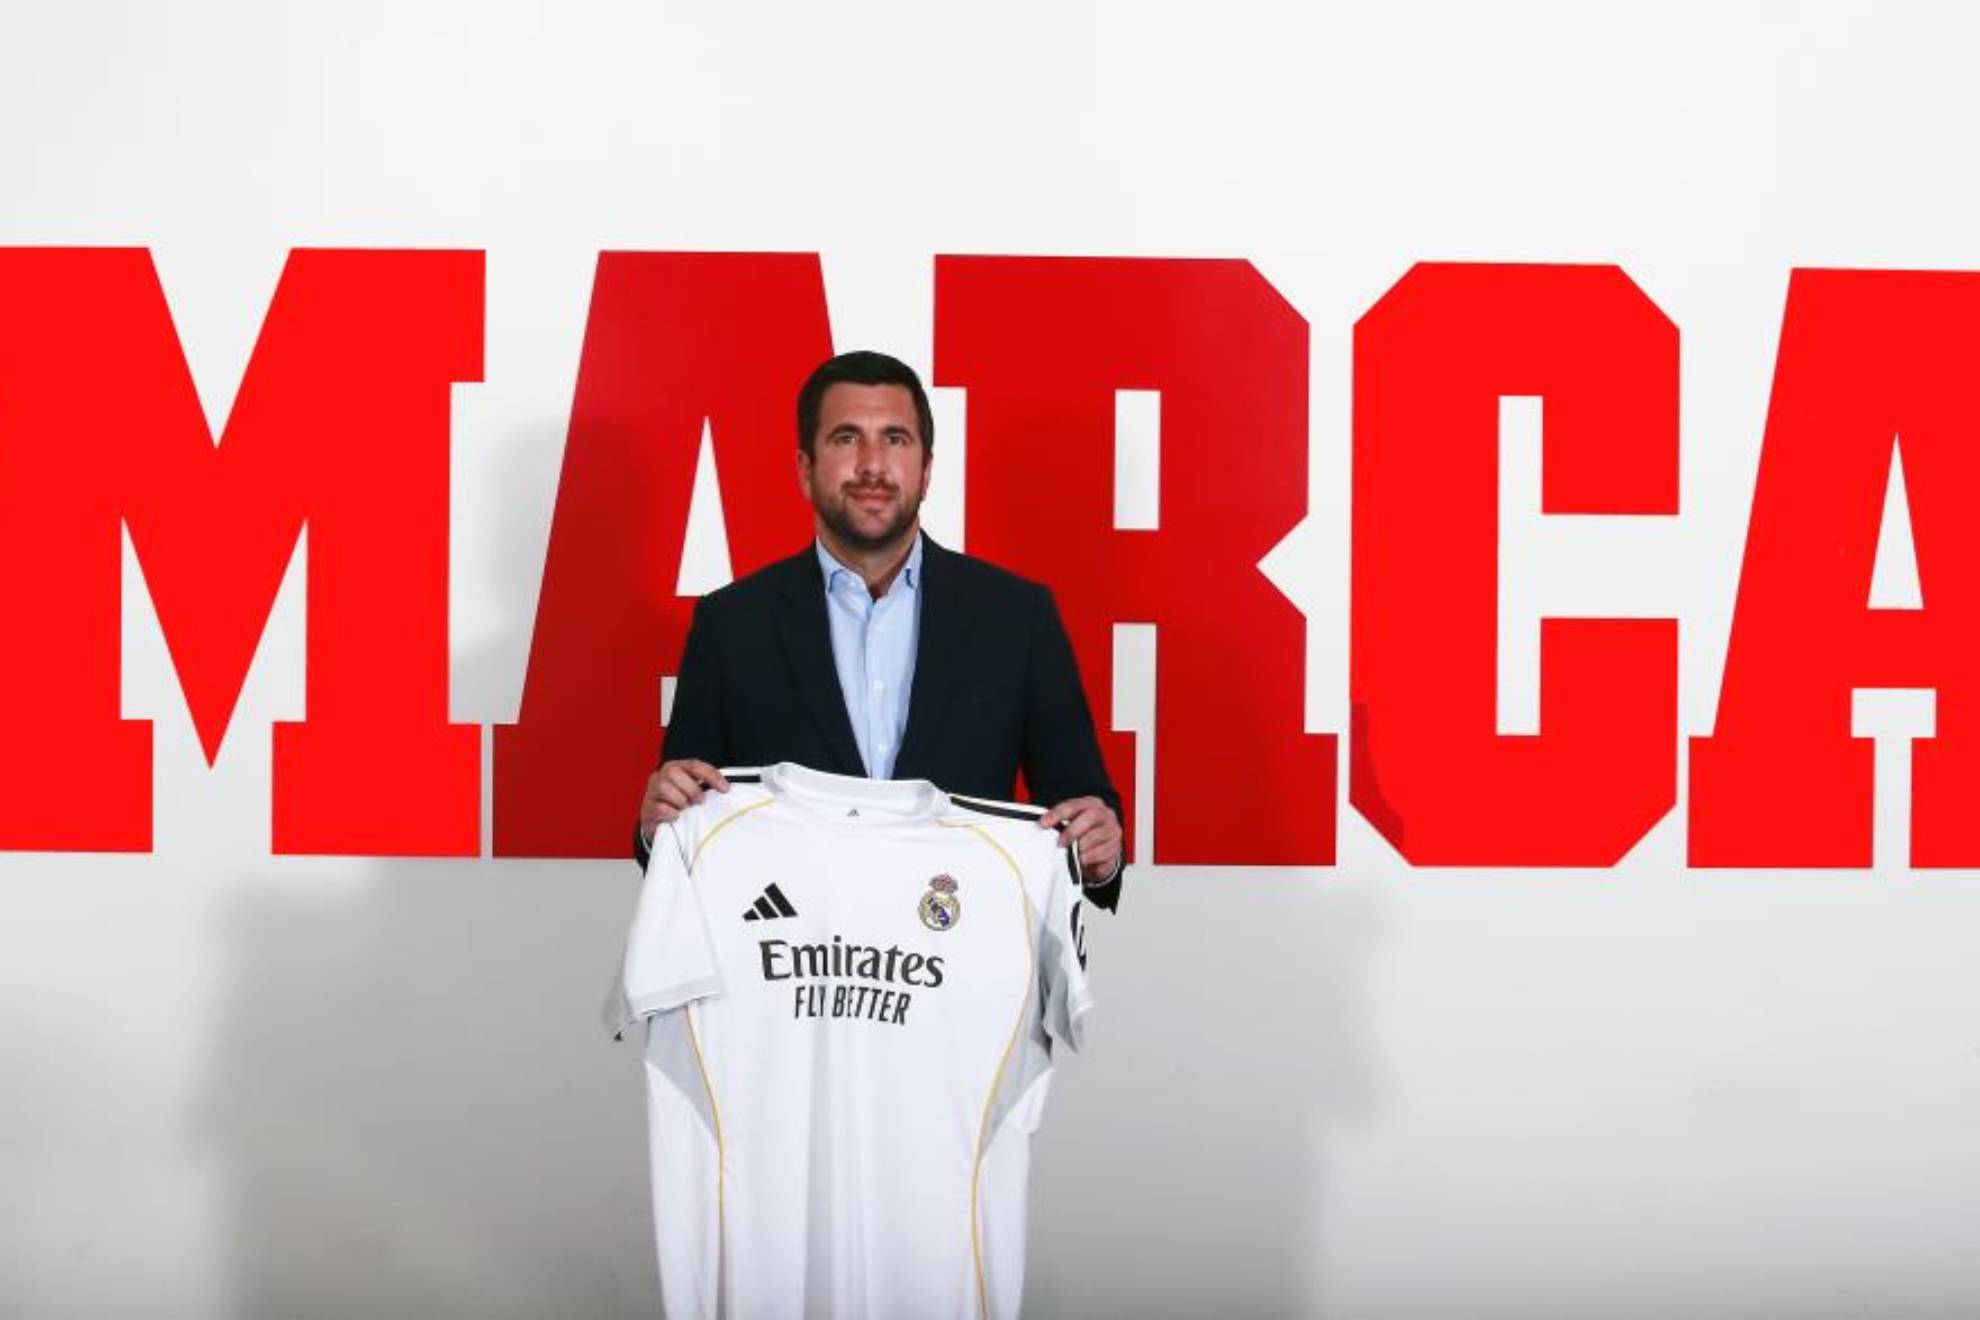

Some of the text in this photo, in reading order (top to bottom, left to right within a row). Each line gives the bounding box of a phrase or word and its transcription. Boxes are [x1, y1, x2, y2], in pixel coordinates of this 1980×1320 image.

[0, 246, 1980, 868] MARCA
[758, 935, 945, 988] Emirates
[794, 984, 912, 1025] FLY BETTER
